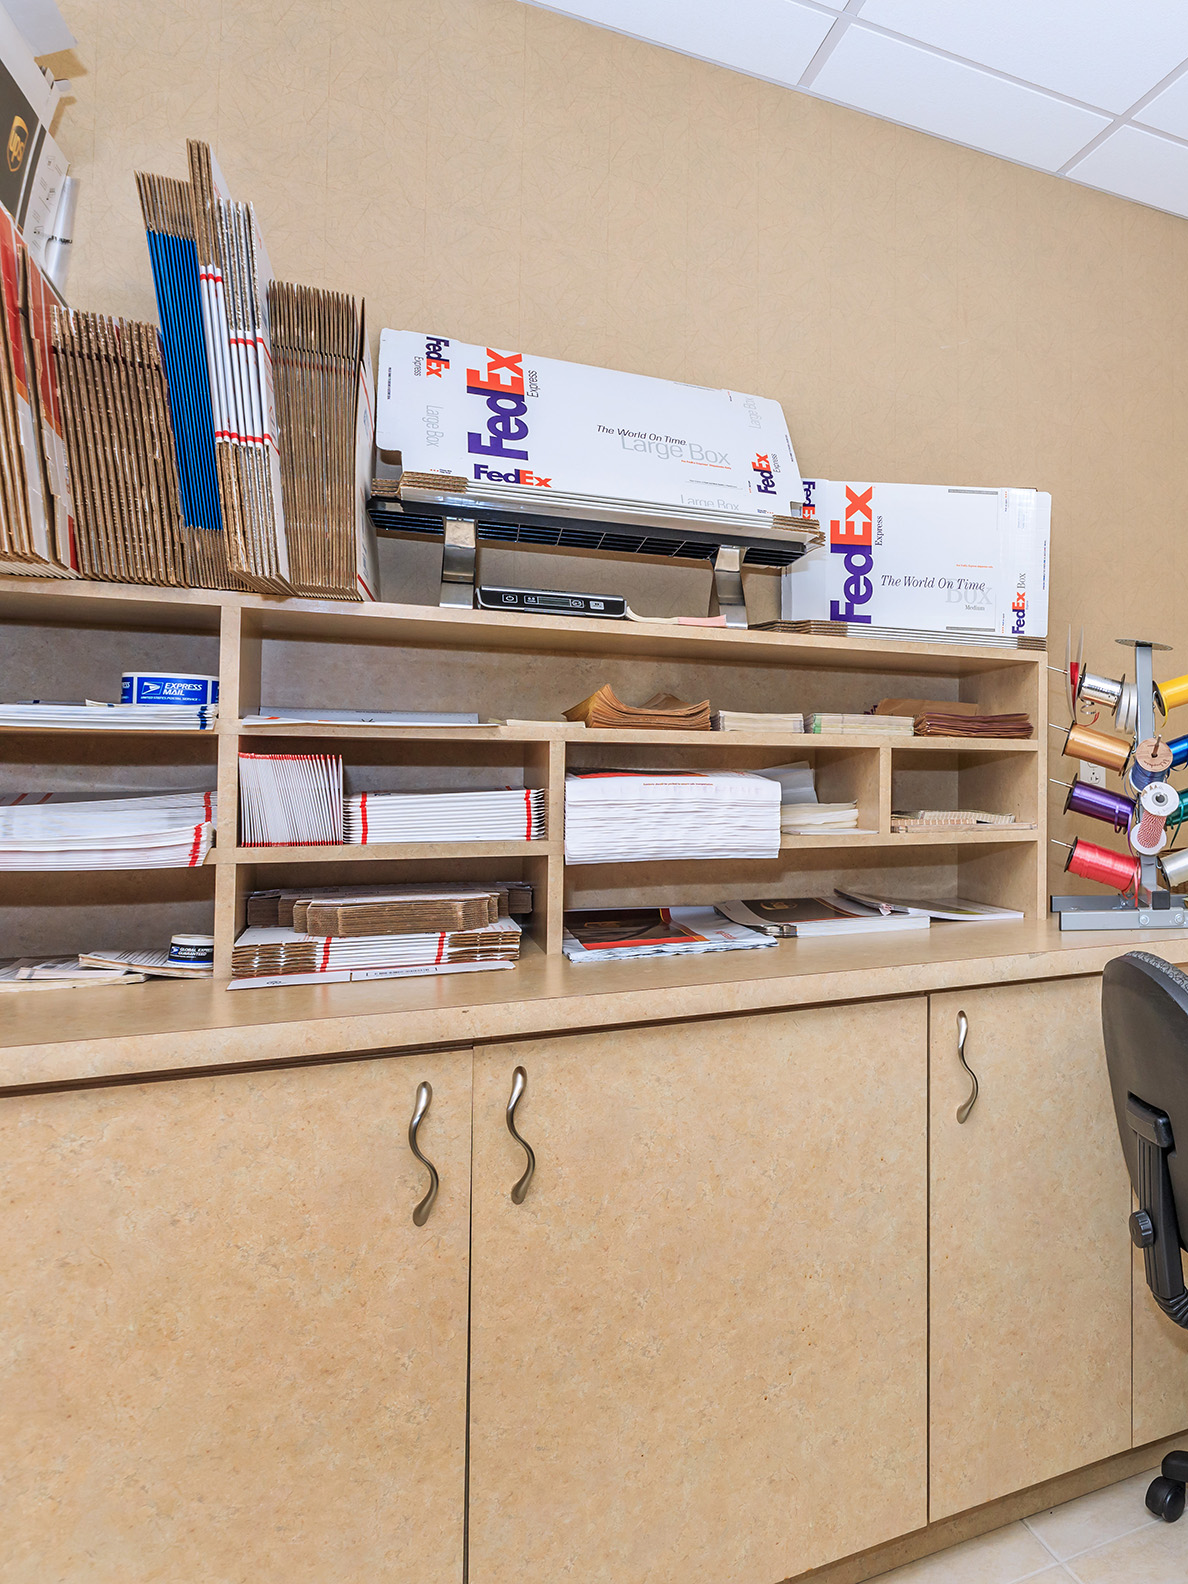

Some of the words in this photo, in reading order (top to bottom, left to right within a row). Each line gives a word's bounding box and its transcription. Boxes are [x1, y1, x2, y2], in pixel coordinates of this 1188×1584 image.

[413, 356, 424, 377] Express
[426, 336, 449, 379] FedEx
[526, 369, 539, 398] Express
[422, 404, 443, 430] Large
[466, 347, 529, 461] FedEx
[426, 430, 444, 448] Box
[597, 424, 615, 435] The
[617, 427, 647, 440] World
[648, 432, 662, 442] On
[621, 434, 683, 460] Large
[688, 442, 731, 465] Box
[473, 463, 552, 488] FedEx
[751, 452, 777, 495] FedEx
[802, 481, 816, 519] FedE
[874, 515, 883, 546] Express
[830, 484, 873, 624] FedEx
[881, 574, 902, 588] The
[903, 575, 935, 589] World
[937, 576, 955, 590] On
[957, 578, 986, 592] Time
[945, 578, 992, 605] Box
[1016, 572, 1027, 589] Box
[1011, 591, 1026, 634] FedEx
[165, 682, 203, 691] EXPRESS
